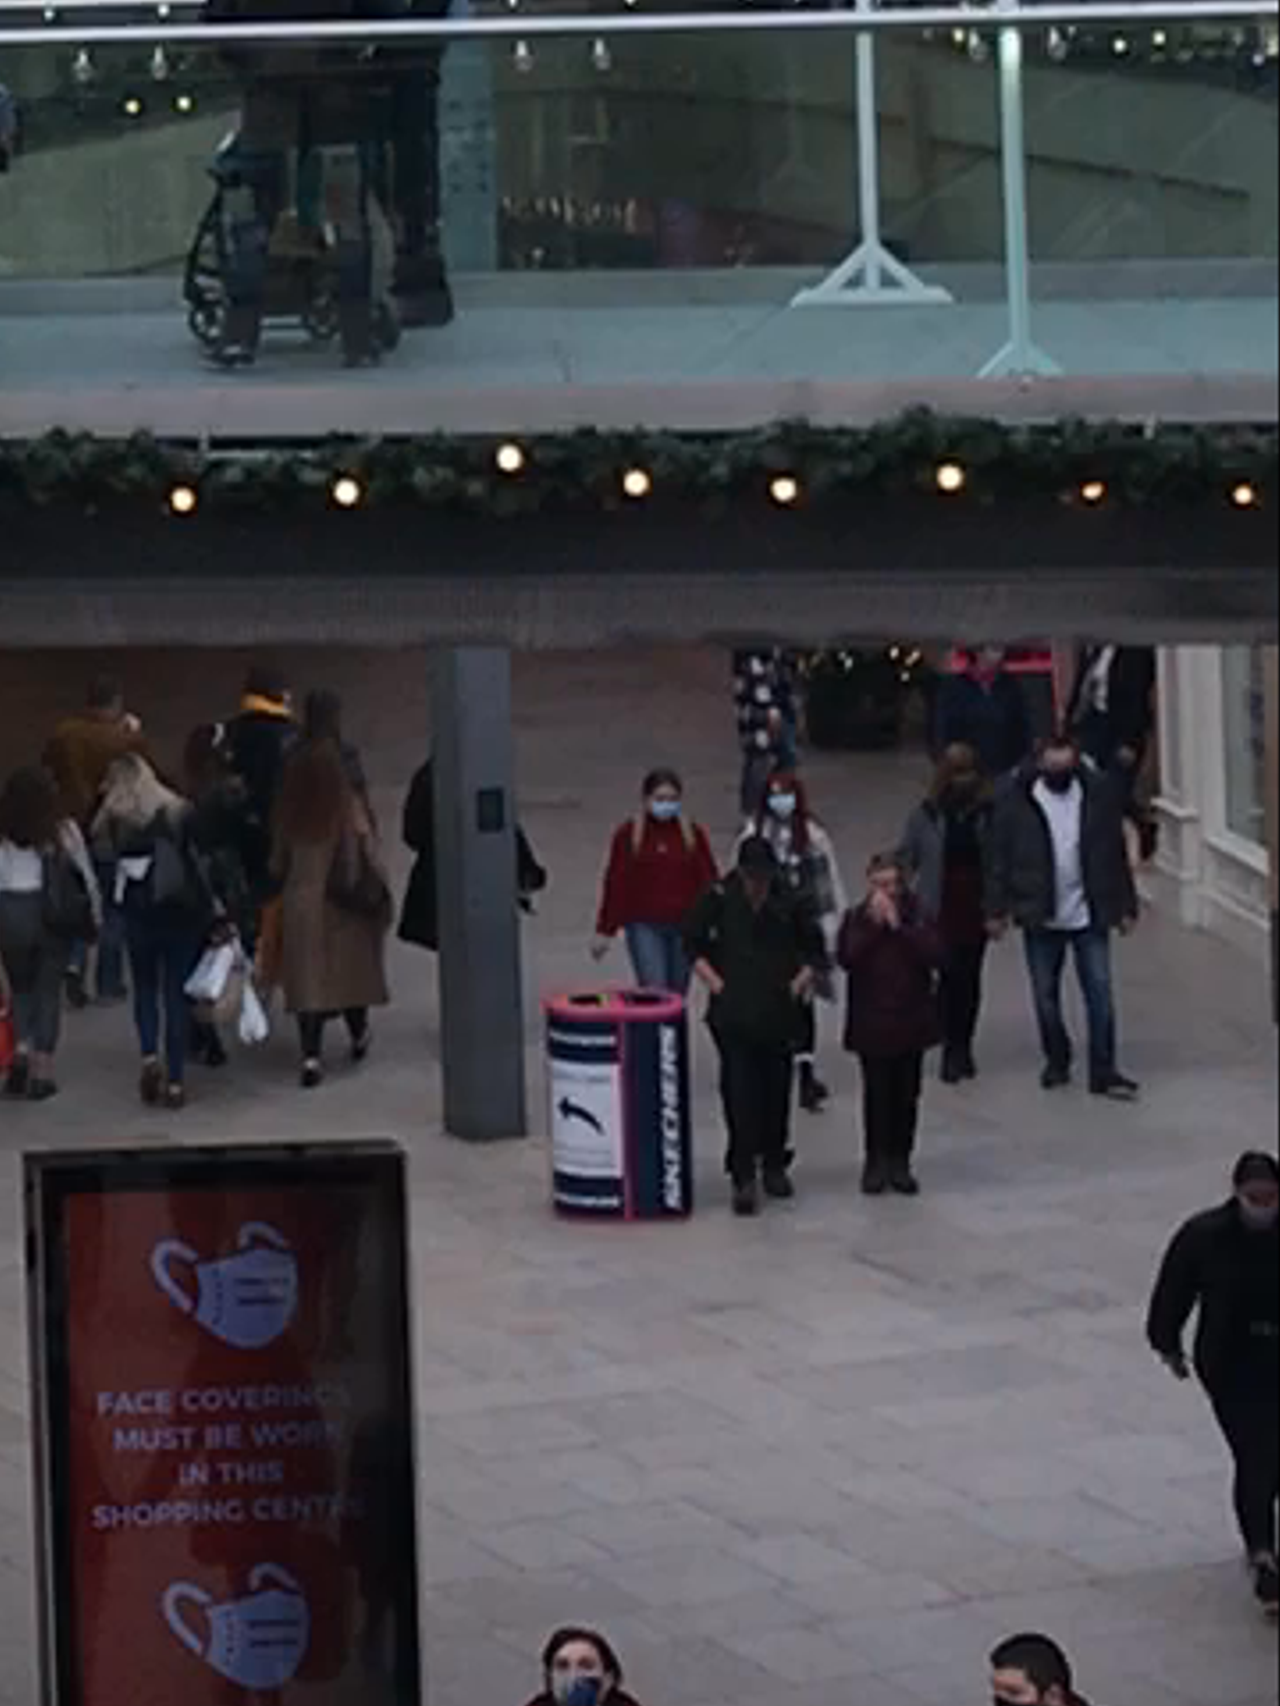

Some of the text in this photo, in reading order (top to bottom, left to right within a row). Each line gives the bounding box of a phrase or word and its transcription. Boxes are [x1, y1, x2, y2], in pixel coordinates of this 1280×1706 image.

[96, 1390, 172, 1416] FACE
[111, 1426, 195, 1451] MUST
[204, 1423, 242, 1450] BE
[178, 1461, 284, 1485] IN THIS
[91, 1497, 245, 1529] SHOPPING
